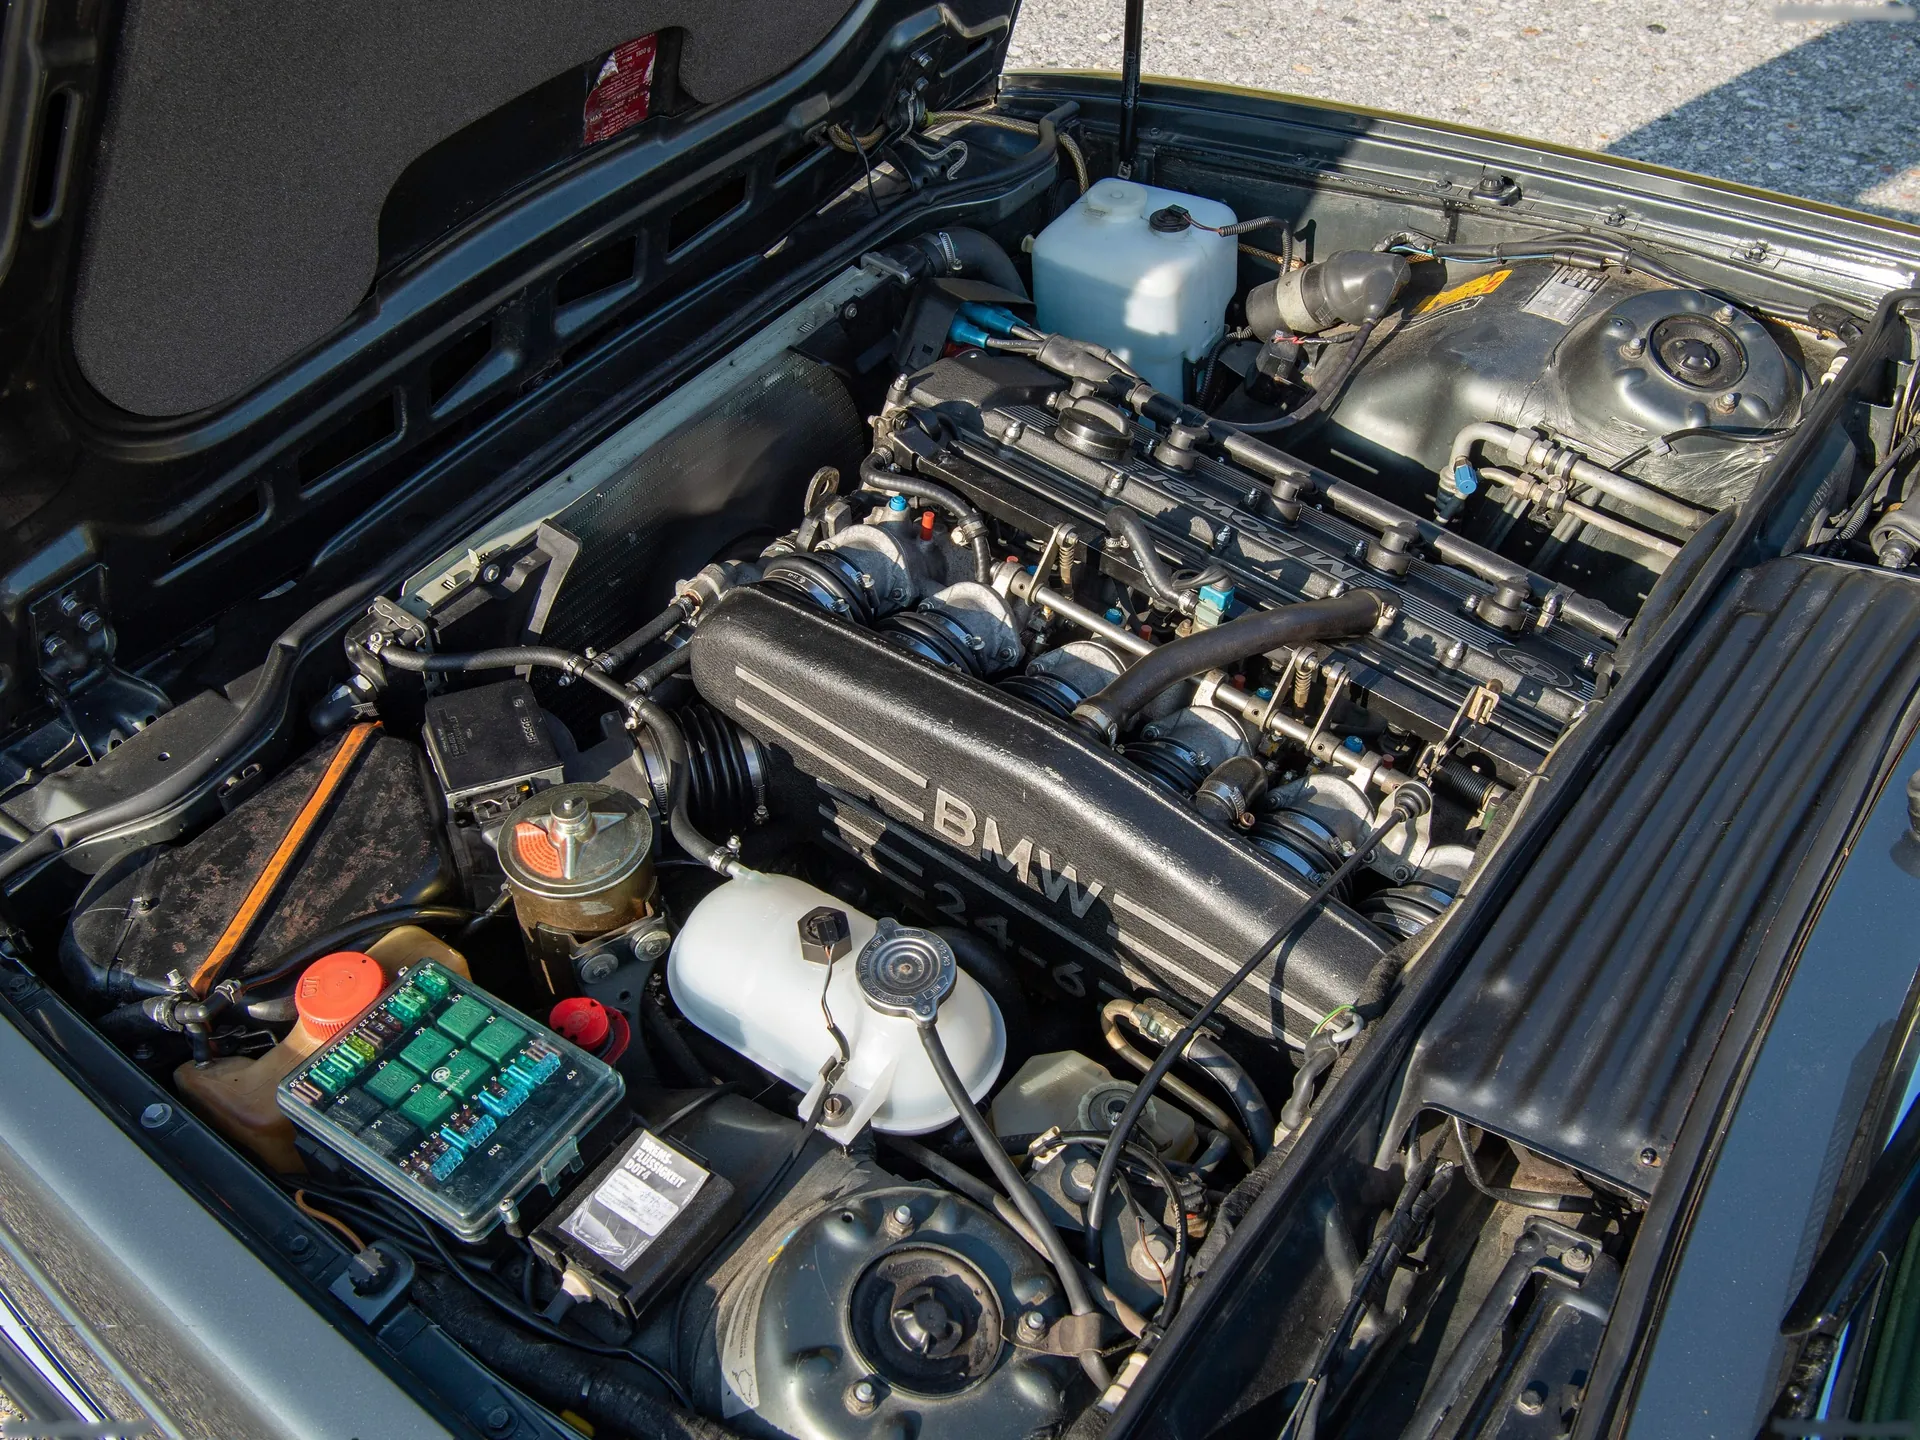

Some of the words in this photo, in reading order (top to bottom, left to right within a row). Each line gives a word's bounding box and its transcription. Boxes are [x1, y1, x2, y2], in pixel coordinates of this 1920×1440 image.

[1137, 471, 1305, 551] Power
[1302, 551, 1360, 580] M
[520, 716, 540, 746] BOSCH
[934, 788, 1104, 918] BMW
[388, 994, 397, 1002] 20
[452, 994, 462, 1002] K5
[369, 1011, 378, 1020] 22
[360, 1020, 369, 1028] 23
[350, 1028, 360, 1036] 24
[415, 1026, 426, 1036] K6
[340, 1036, 350, 1044] 25
[330, 1044, 340, 1052] 26
[448, 1048, 460, 1058] K2
[310, 1060, 320, 1069] 28
[378, 1060, 388, 1070] K7
[299, 1070, 308, 1080] 29
[566, 1070, 577, 1080] K9
[290, 1079, 300, 1088] 30
[410, 1084, 422, 1093] K3
[338, 1094, 349, 1104] K8
[450, 1112, 460, 1120] 10
[372, 1120, 383, 1130] K4
[430, 1131, 440, 1139] 12
[410, 1150, 420, 1158] 14
[488, 1144, 502, 1156] K10
